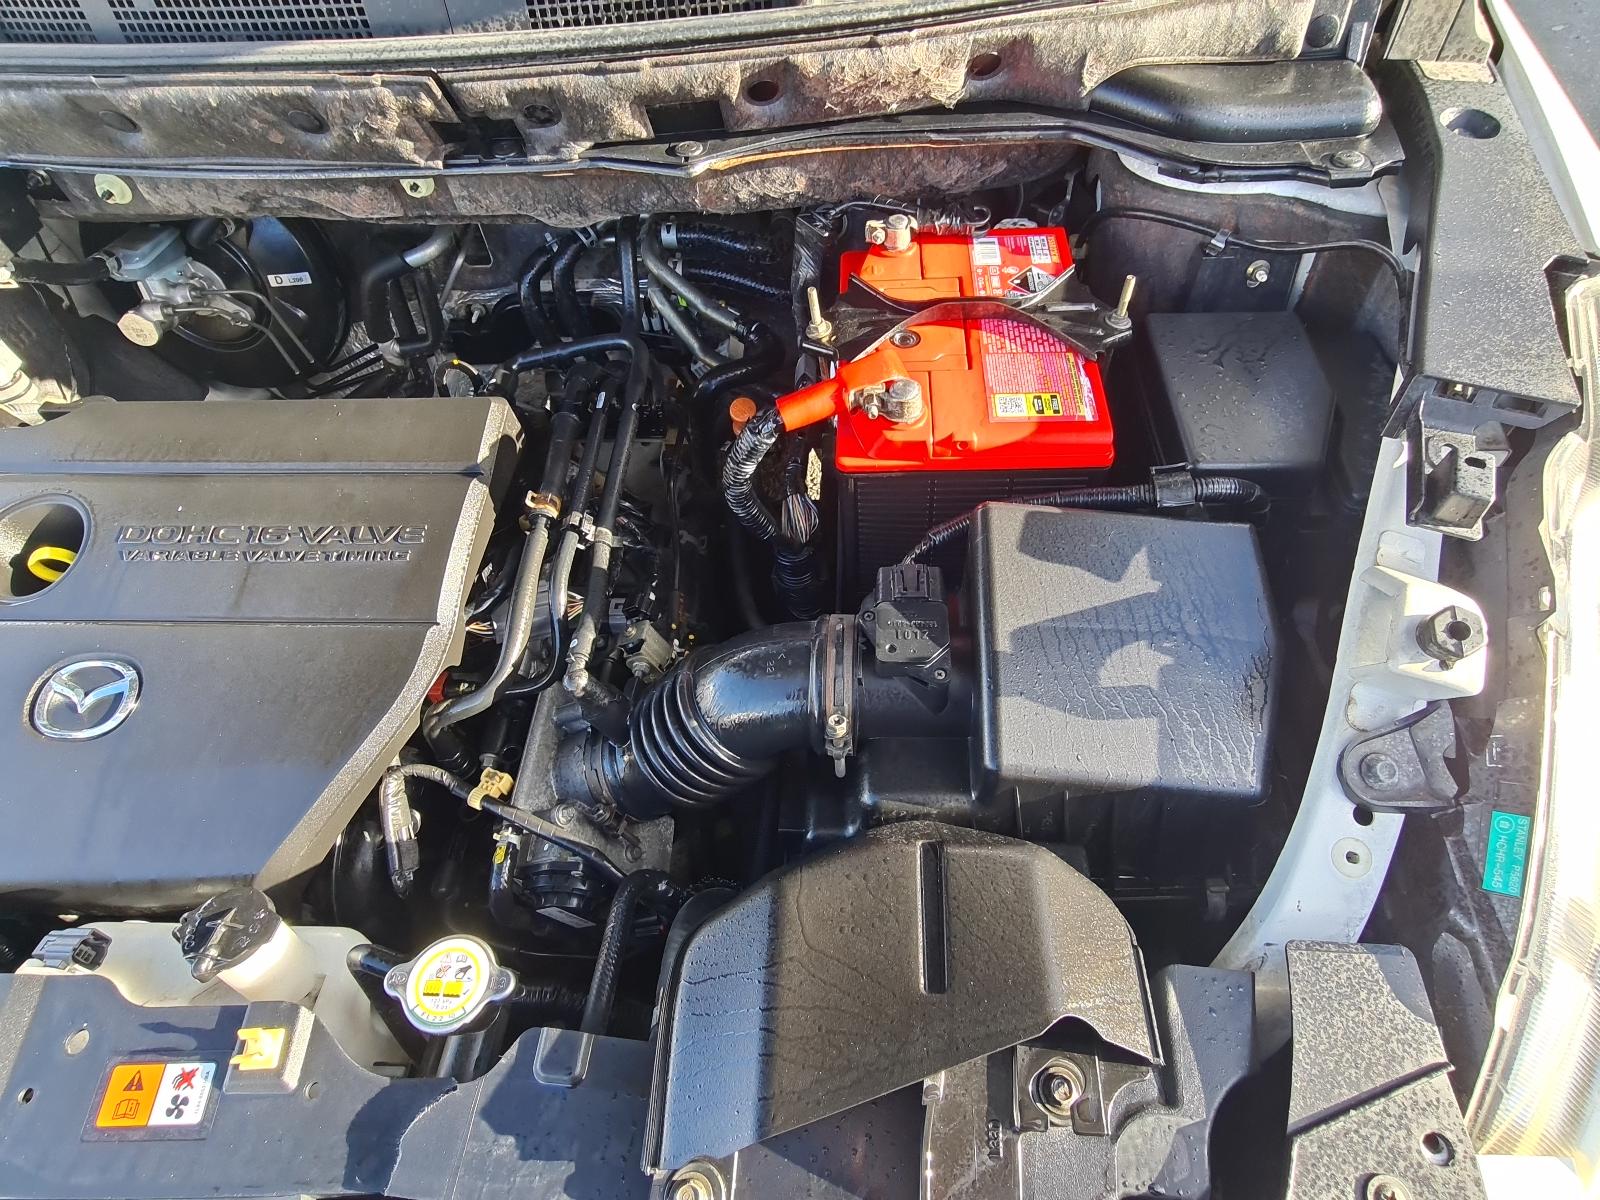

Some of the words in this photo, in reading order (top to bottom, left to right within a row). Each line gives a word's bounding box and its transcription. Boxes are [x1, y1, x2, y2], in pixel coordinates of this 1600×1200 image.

[116, 524, 246, 545] DOHC
[120, 549, 241, 562] VARIABLE
[243, 549, 320, 562] VALVE
[322, 549, 412, 562] TIMING
[1513, 818, 1528, 861] STANLEY
